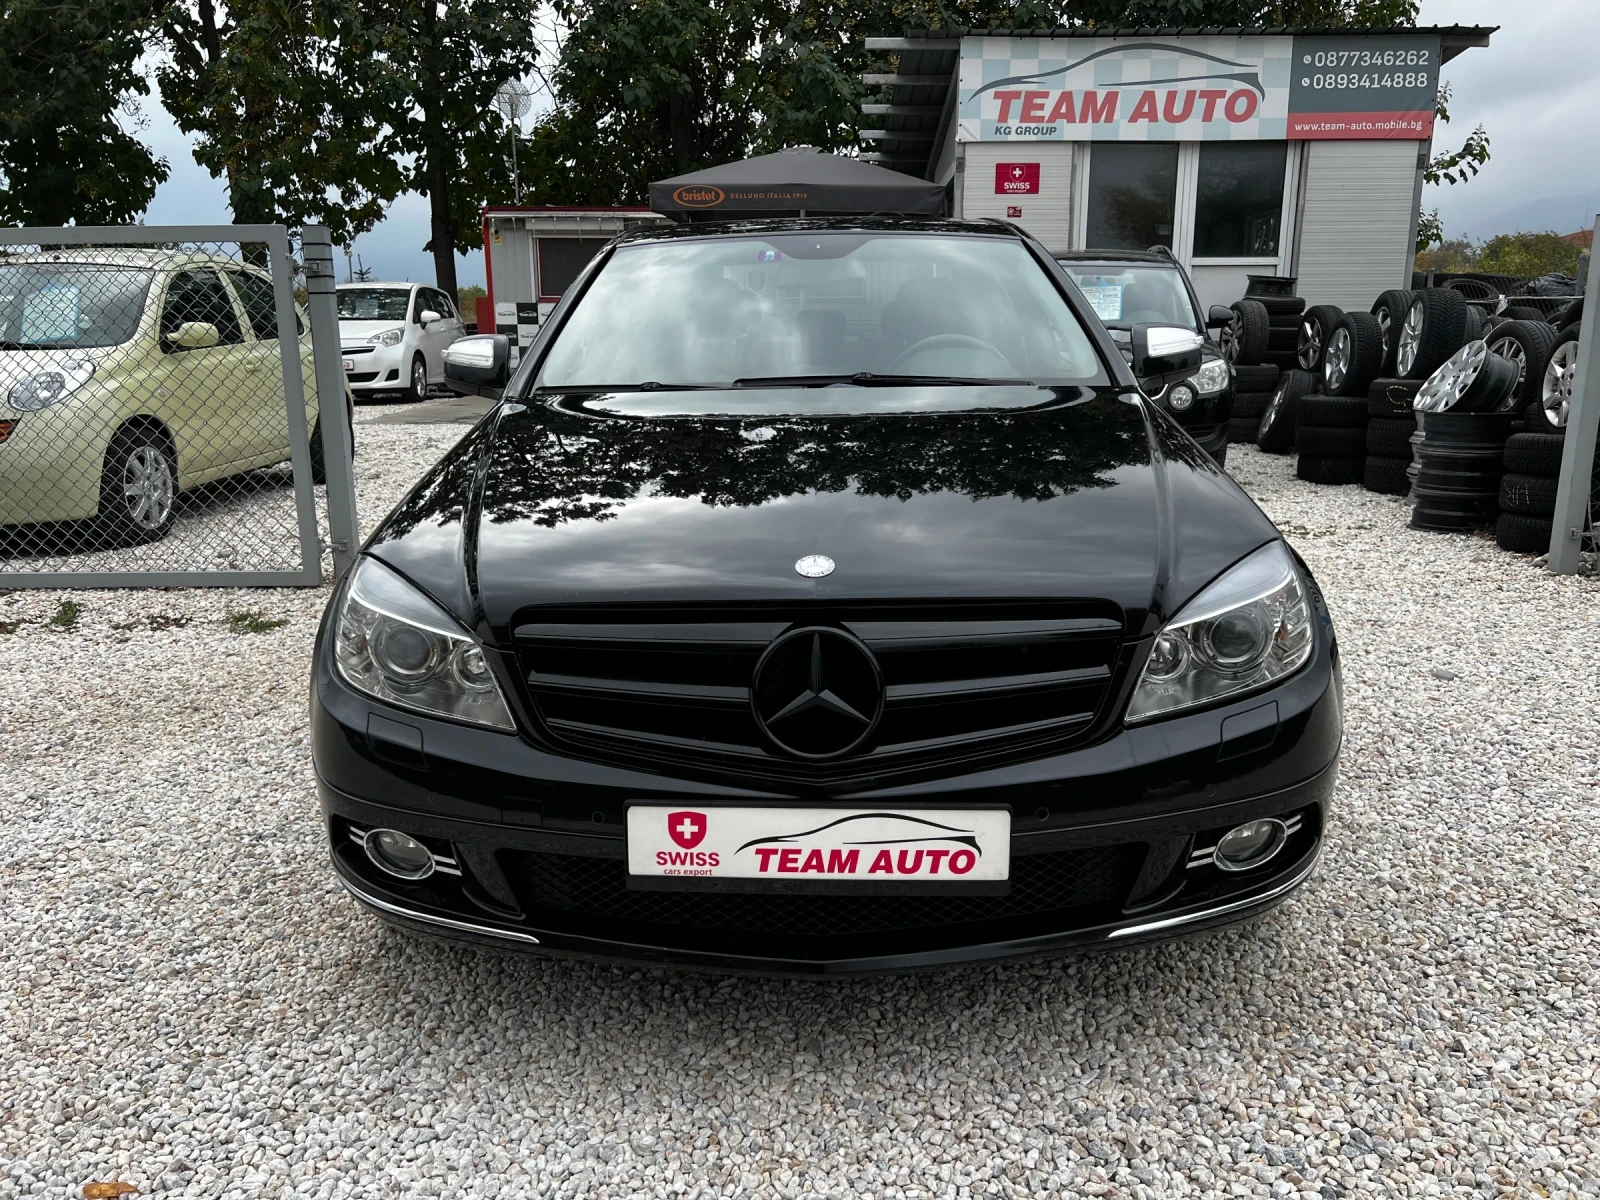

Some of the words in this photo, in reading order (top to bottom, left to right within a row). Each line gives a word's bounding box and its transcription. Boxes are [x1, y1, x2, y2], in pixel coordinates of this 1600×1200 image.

[1314, 50, 1429, 67] 0877346262
[1313, 72, 1428, 89] 0893414888
[993, 90, 1119, 124] TEAM
[1127, 88, 1258, 124] AUTO
[994, 126, 1012, 136] KG
[1015, 126, 1057, 136] GROUP
[1294, 120, 1423, 132] www.team-auto.mobile.bg
[1003, 182, 1030, 190] SWISS
[682, 190, 716, 201] bristot
[656, 850, 720, 867] SWISS
[754, 848, 860, 874] TEAM
[867, 848, 976, 875] AUTO
[683, 868, 713, 878] export
